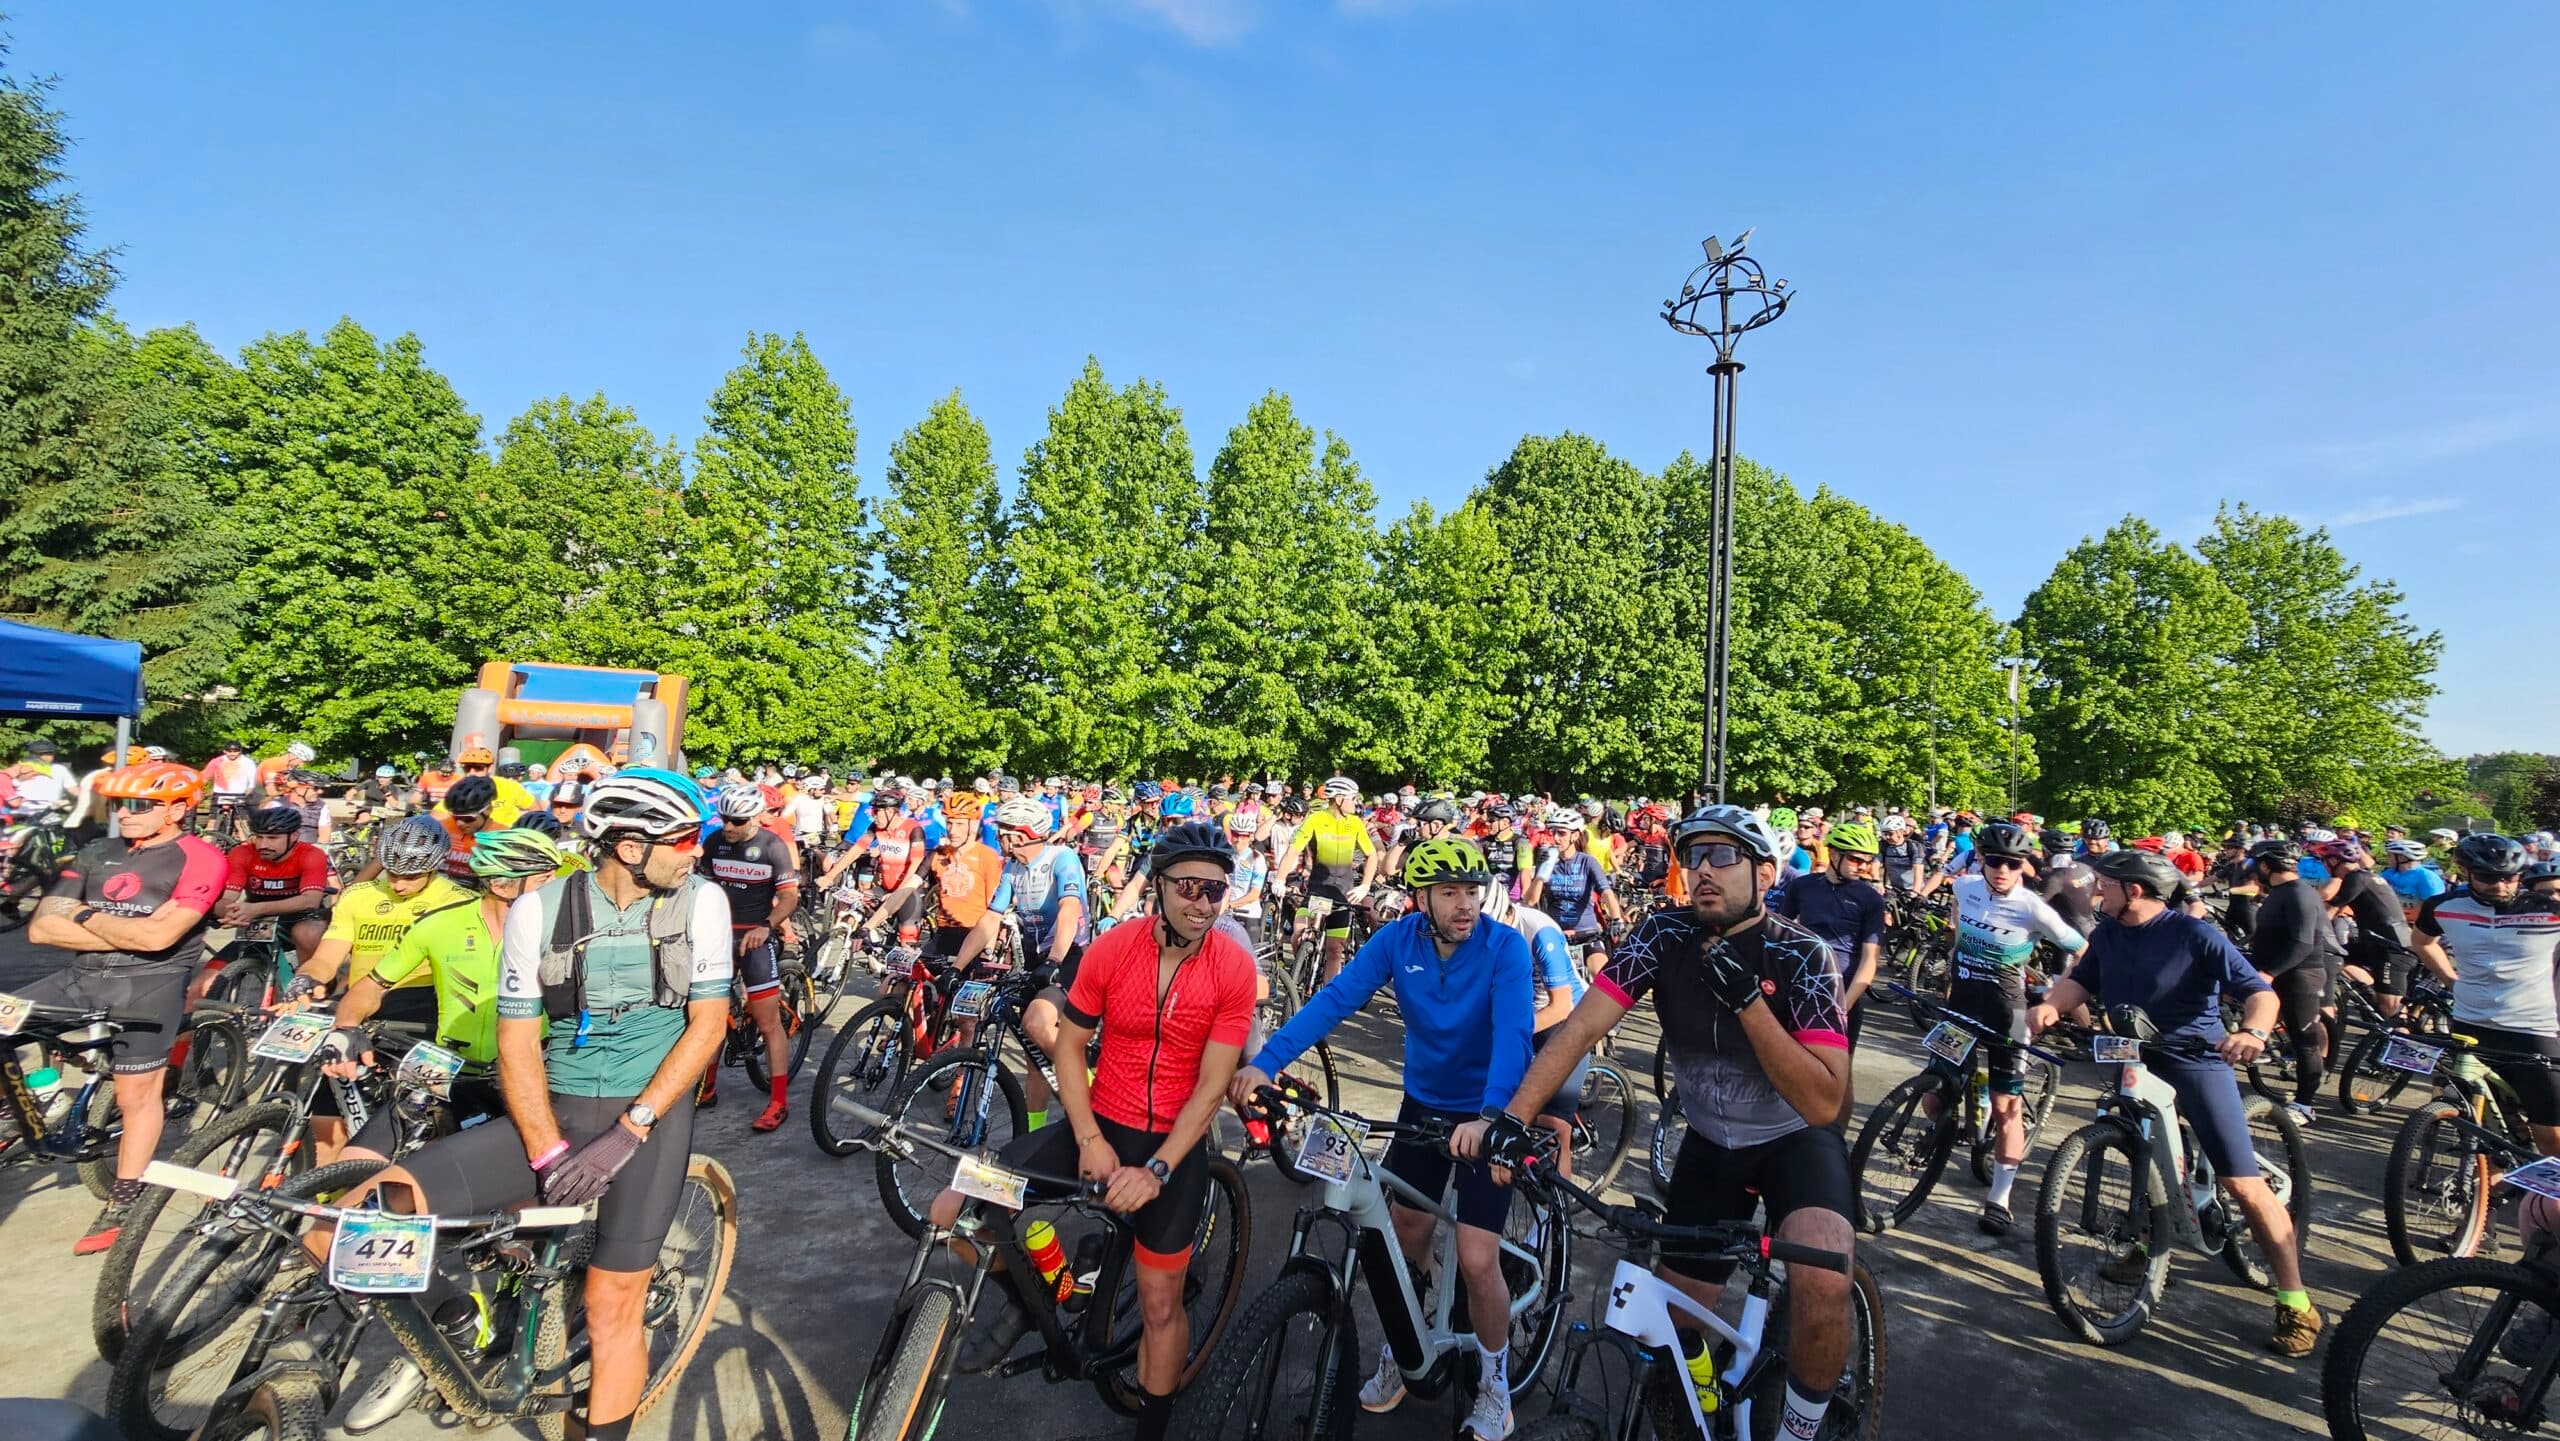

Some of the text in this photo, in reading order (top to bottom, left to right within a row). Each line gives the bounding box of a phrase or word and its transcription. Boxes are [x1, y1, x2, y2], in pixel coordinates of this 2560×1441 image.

[1960, 914, 2016, 935] SCOTT
[280, 1027, 317, 1043] 467
[1325, 1136, 1348, 1156] 93
[355, 1238, 415, 1260] 474
